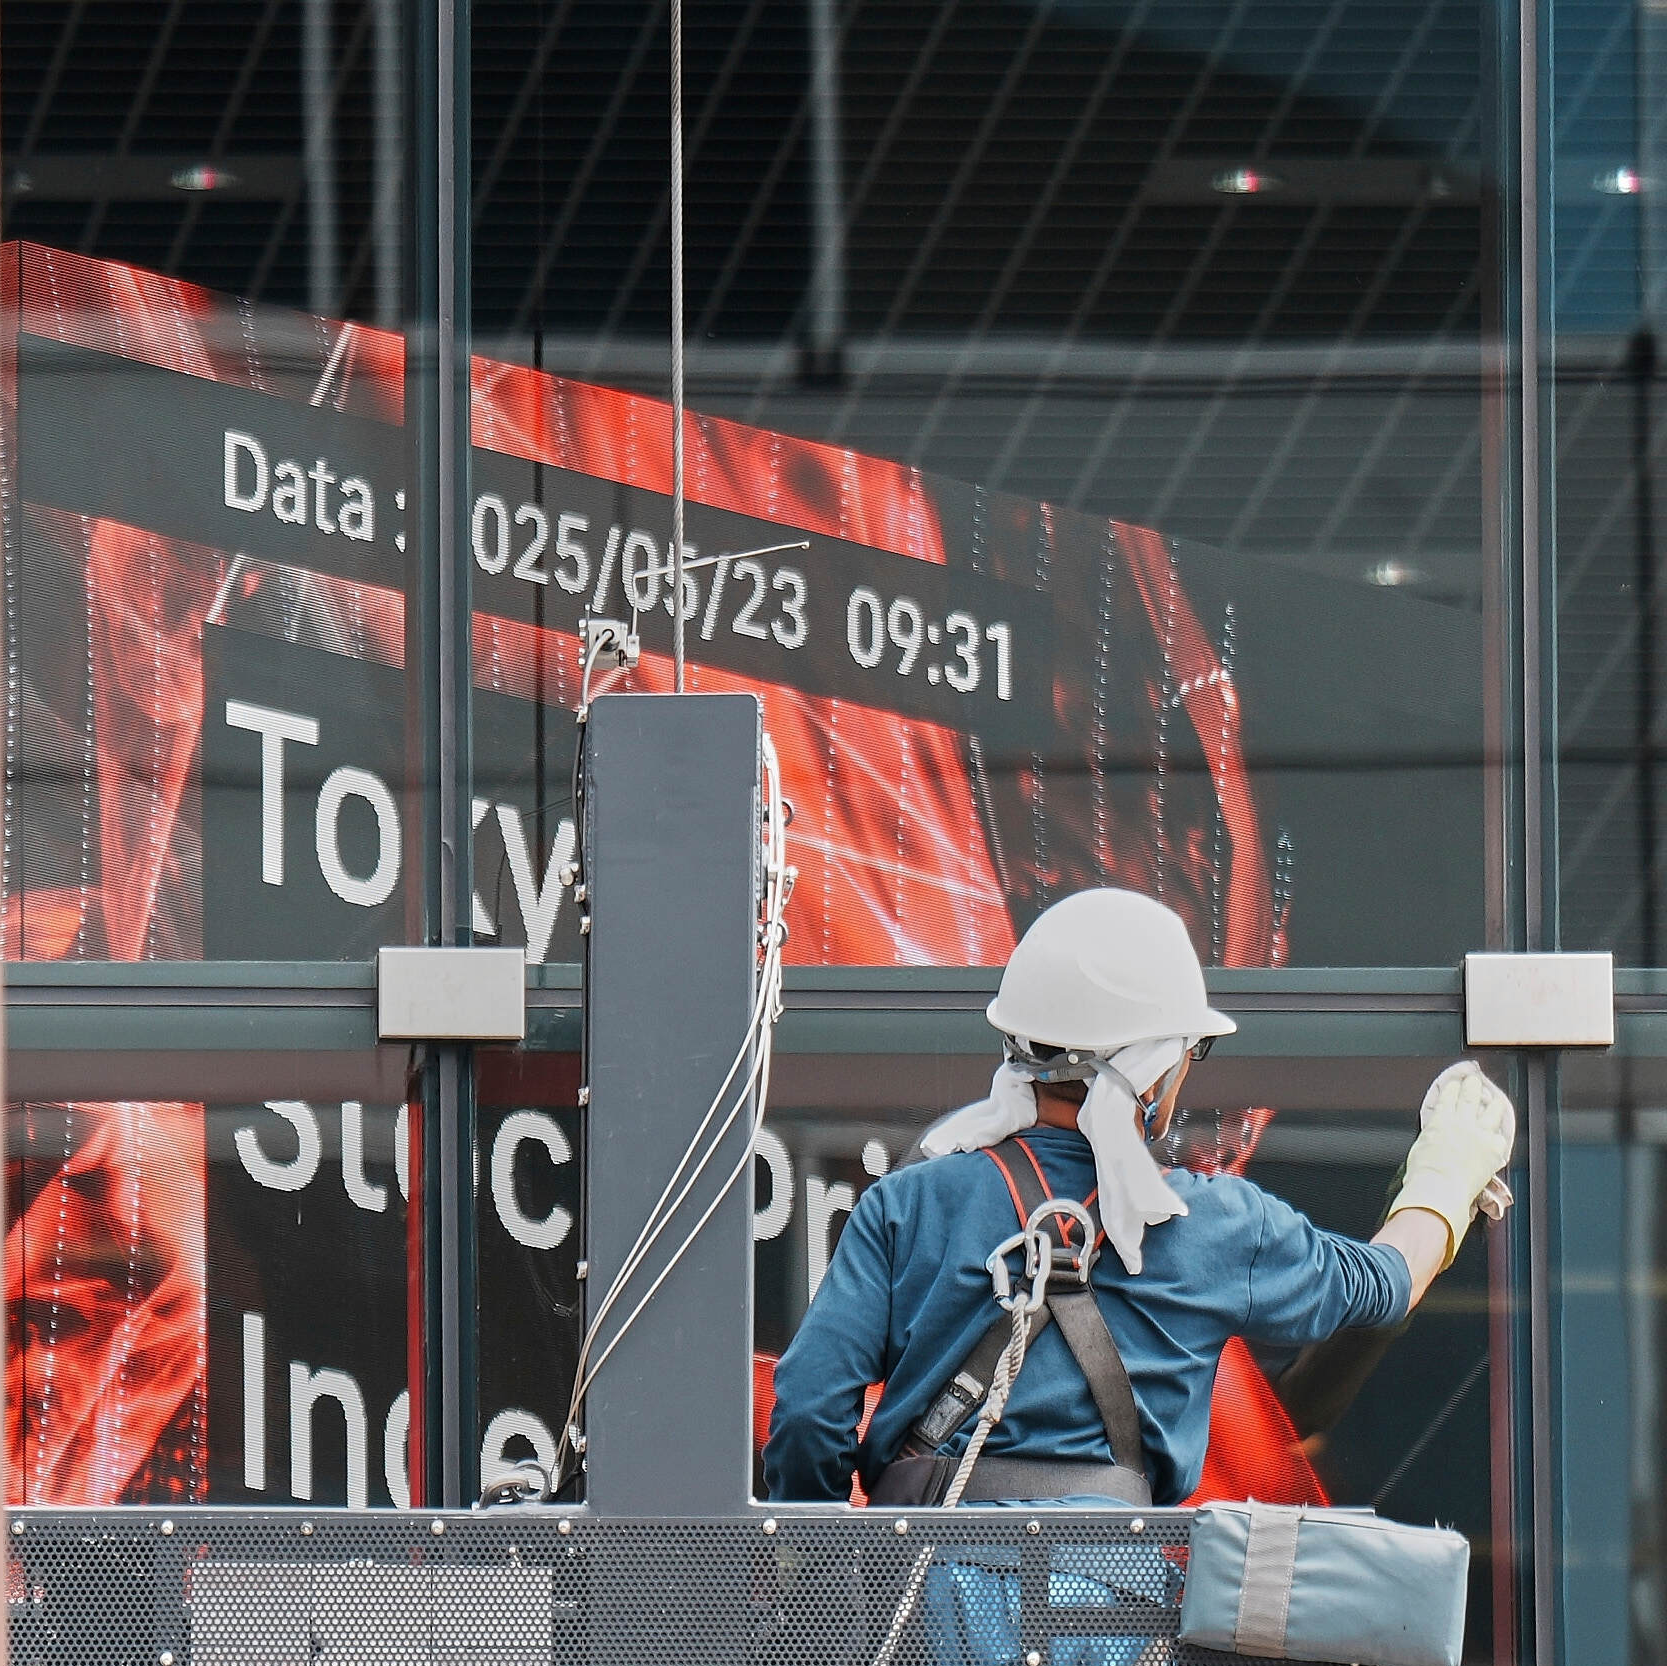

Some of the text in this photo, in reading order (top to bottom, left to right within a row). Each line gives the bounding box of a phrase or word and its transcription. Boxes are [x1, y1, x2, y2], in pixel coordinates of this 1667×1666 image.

[223, 429, 375, 542] Data
[471, 492, 809, 650] 025/05/23
[846, 585, 1013, 701] 09:31
